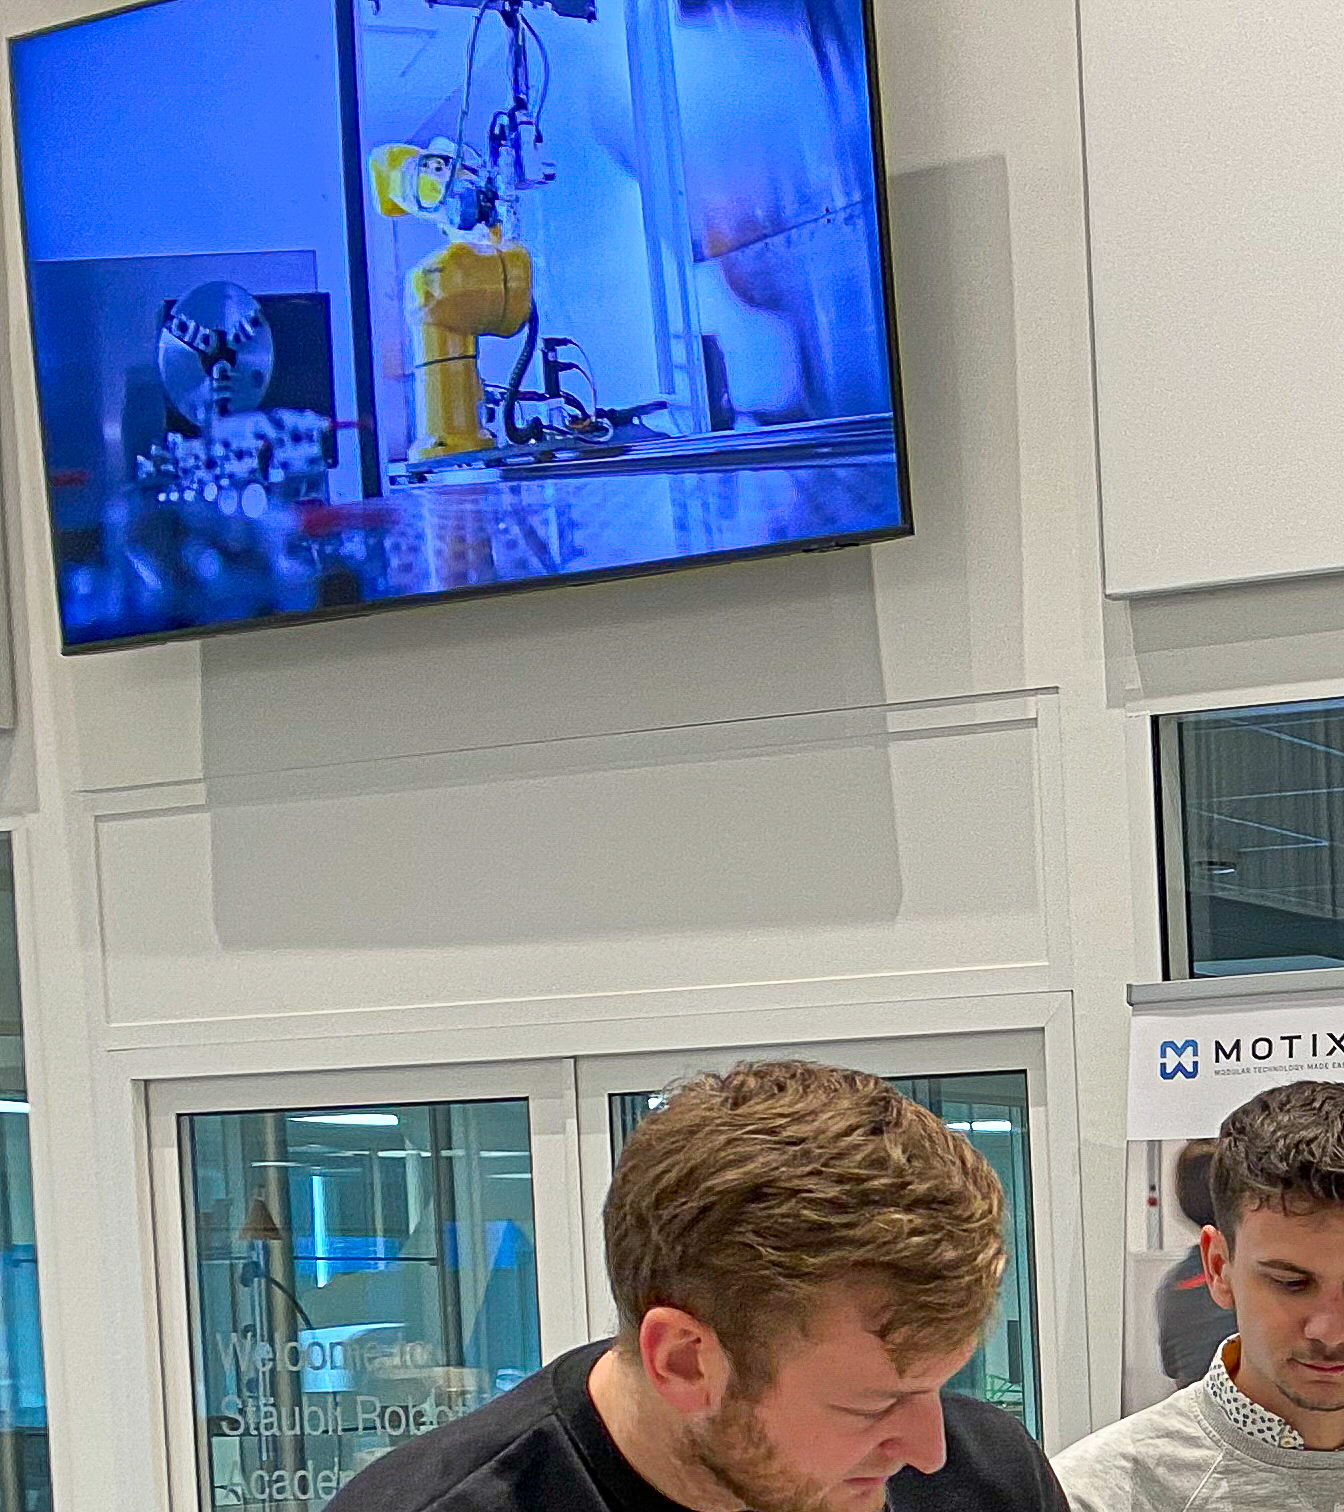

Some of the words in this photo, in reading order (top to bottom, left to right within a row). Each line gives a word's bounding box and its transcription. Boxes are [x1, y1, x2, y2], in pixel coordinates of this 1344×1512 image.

[1214, 1066, 1252, 1077] MODULAR
[1253, 1064, 1304, 1074] TECHNOLOGY
[1307, 1062, 1330, 1071] MADE
[220, 1394, 342, 1436] Stäubli
[227, 1456, 356, 1501] Acade
